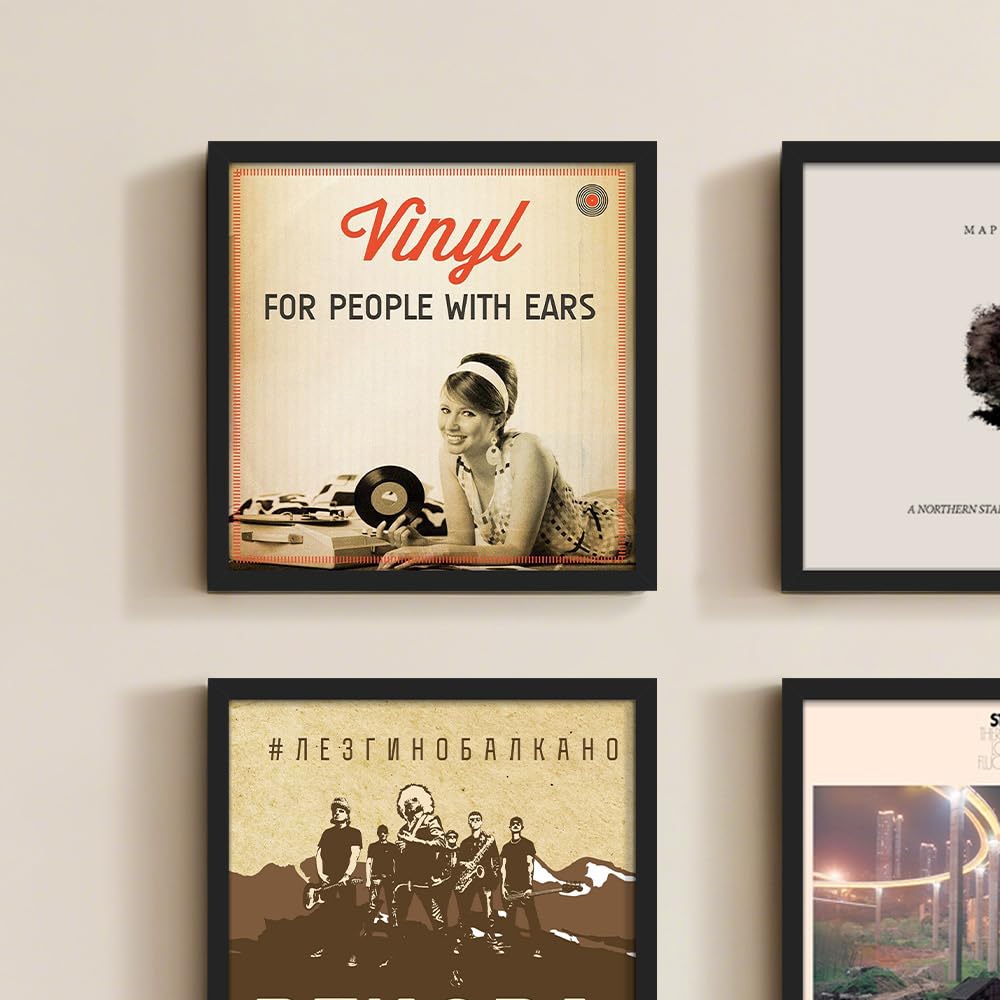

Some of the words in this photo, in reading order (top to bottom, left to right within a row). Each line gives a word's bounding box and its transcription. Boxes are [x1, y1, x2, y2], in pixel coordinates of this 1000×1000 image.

[341, 196, 531, 286] Vinyl
[264, 293, 316, 321] FOR
[330, 293, 433, 321] PEOPLE
[444, 293, 511, 321] WITH
[525, 293, 597, 321] EARS
[907, 504, 916, 515] A
[917, 504, 978, 515] NORTHERN
[268, 737, 620, 761] #ЛЕЗГИНОБАЛКАНО
